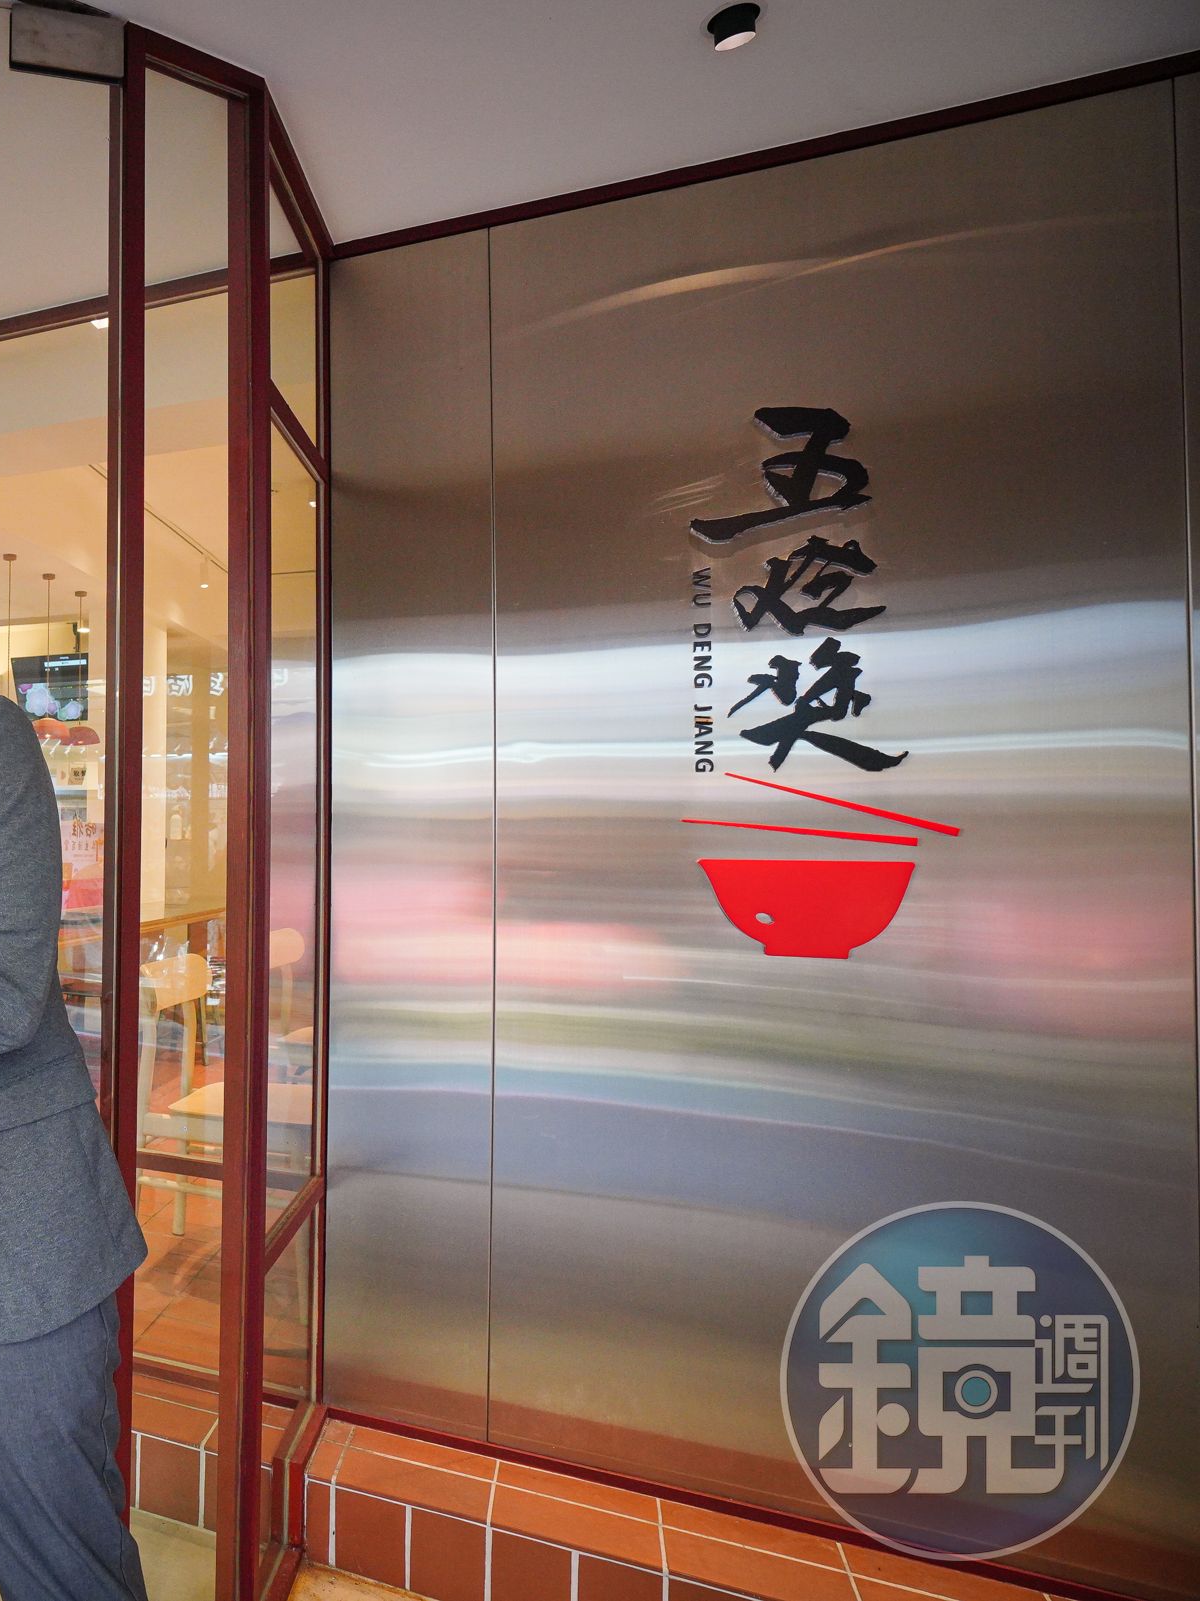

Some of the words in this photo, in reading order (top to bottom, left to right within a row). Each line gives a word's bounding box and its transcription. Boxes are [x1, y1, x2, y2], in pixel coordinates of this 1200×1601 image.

[692, 567, 712, 608] WU
[693, 623, 713, 689] DENG
[694, 704, 715, 774] JIANG
